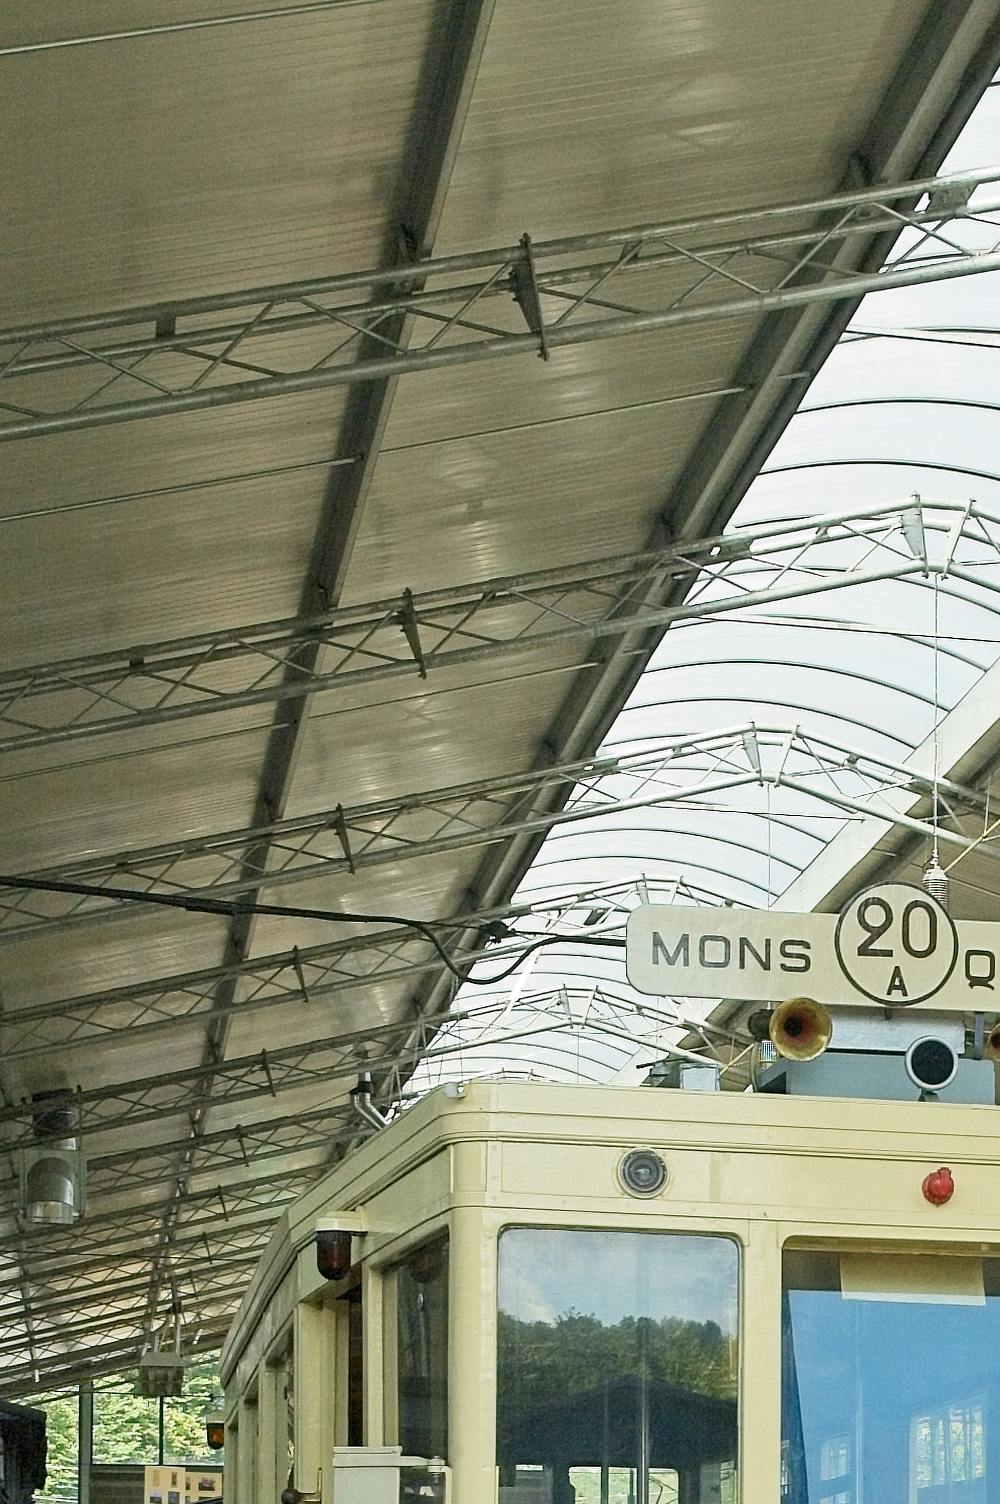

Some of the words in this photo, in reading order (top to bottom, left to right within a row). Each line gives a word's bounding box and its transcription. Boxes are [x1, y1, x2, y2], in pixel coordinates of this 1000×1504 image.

[857, 897, 939, 958] 20
[652, 931, 812, 974] MONS
[886, 965, 909, 997] A
